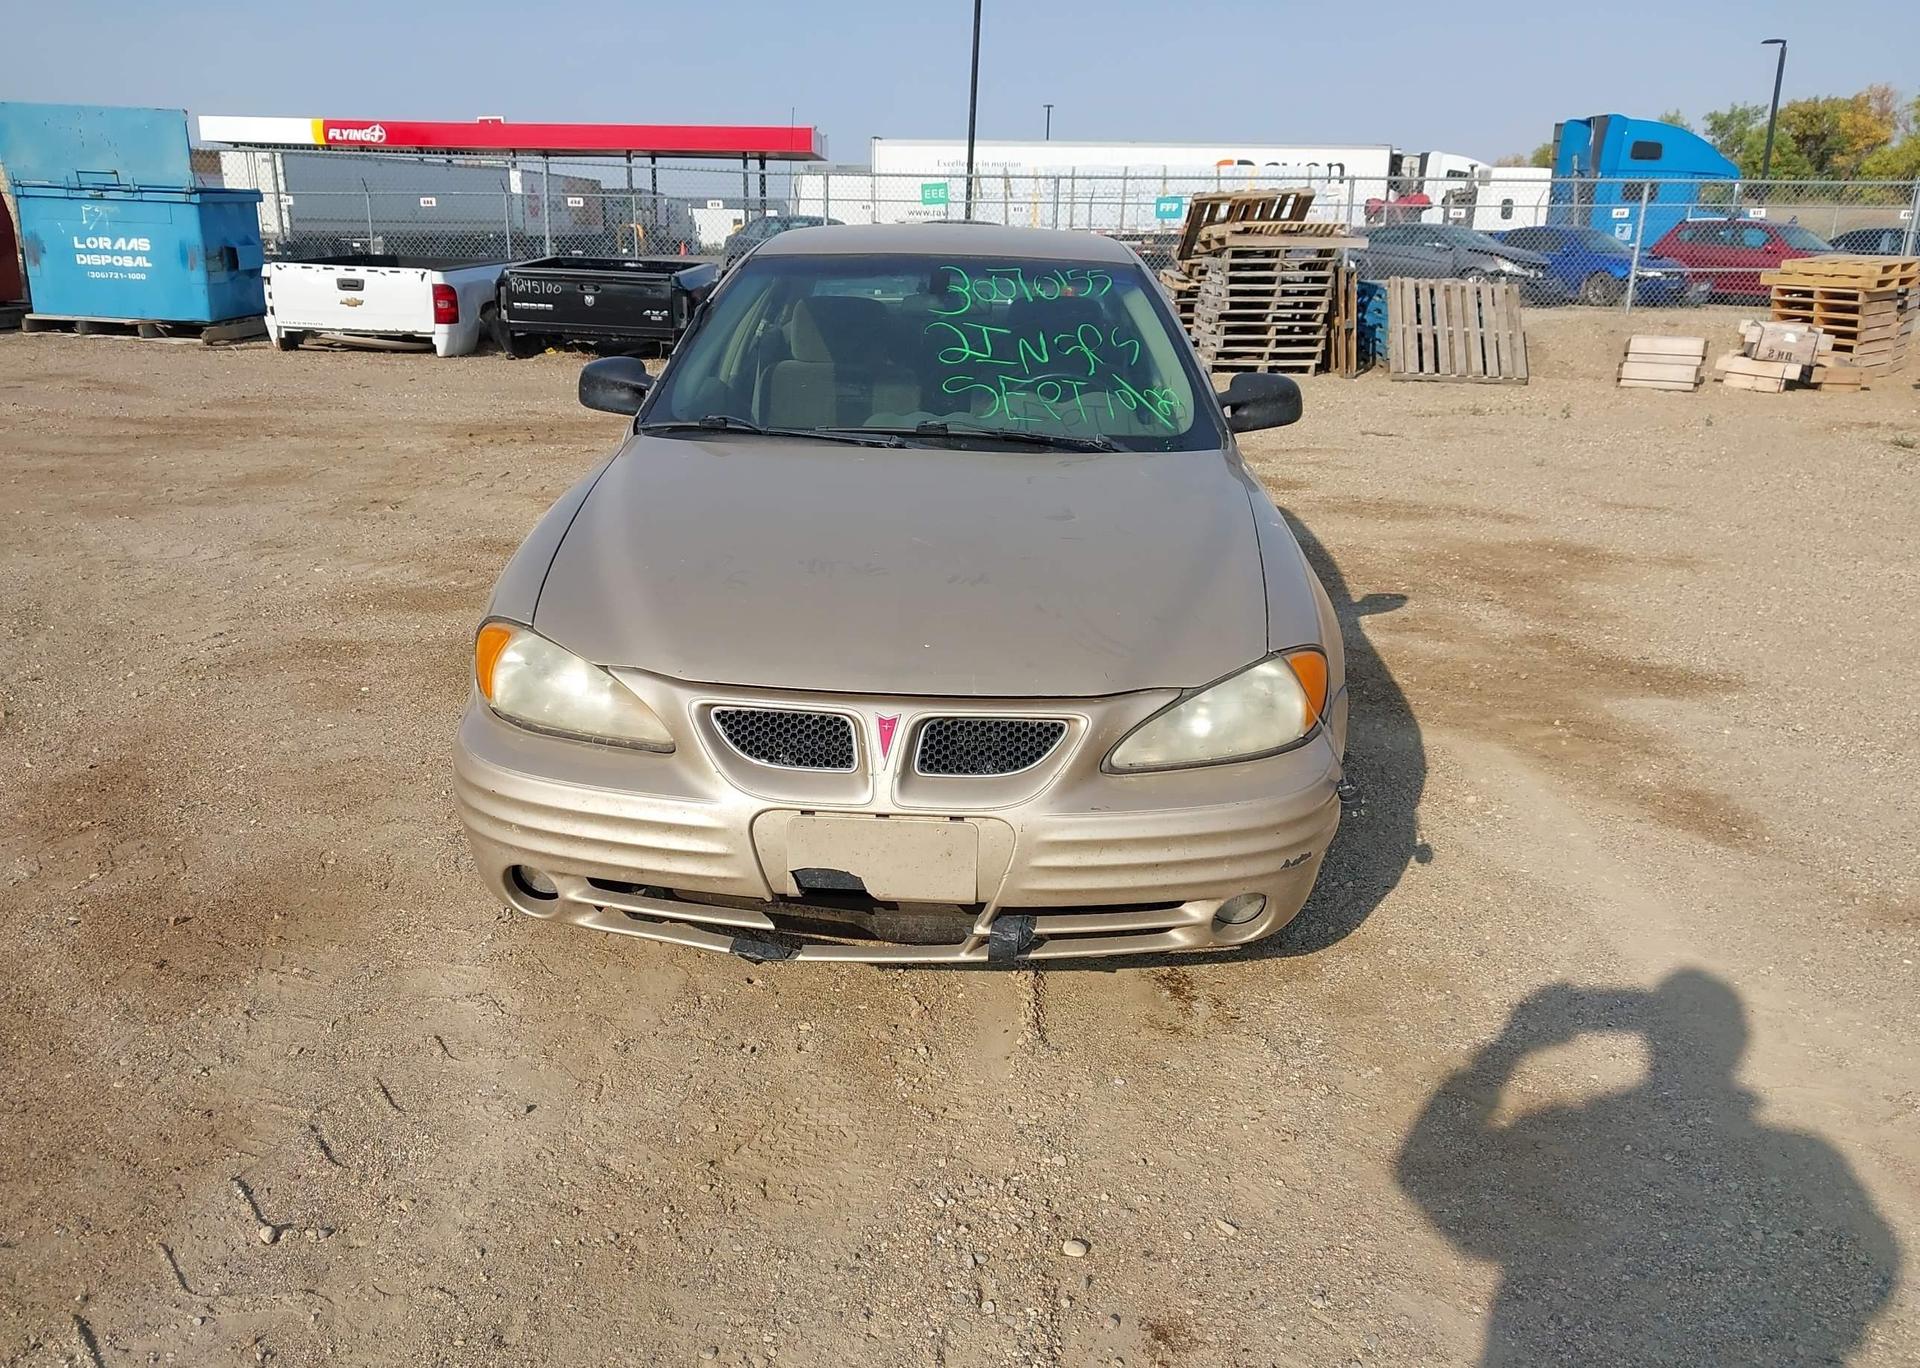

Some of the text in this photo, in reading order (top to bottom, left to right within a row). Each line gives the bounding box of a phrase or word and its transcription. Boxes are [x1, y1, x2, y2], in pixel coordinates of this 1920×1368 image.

[328, 128, 371, 141] FLYING
[982, 160, 991, 168] in
[992, 160, 1022, 168] motion
[924, 188, 946, 199] EEE
[73, 236, 151, 251] LORAAS
[76, 253, 152, 267] DISPOSAL
[509, 277, 563, 295] R245100
[942, 375, 1089, 423] SEPT
